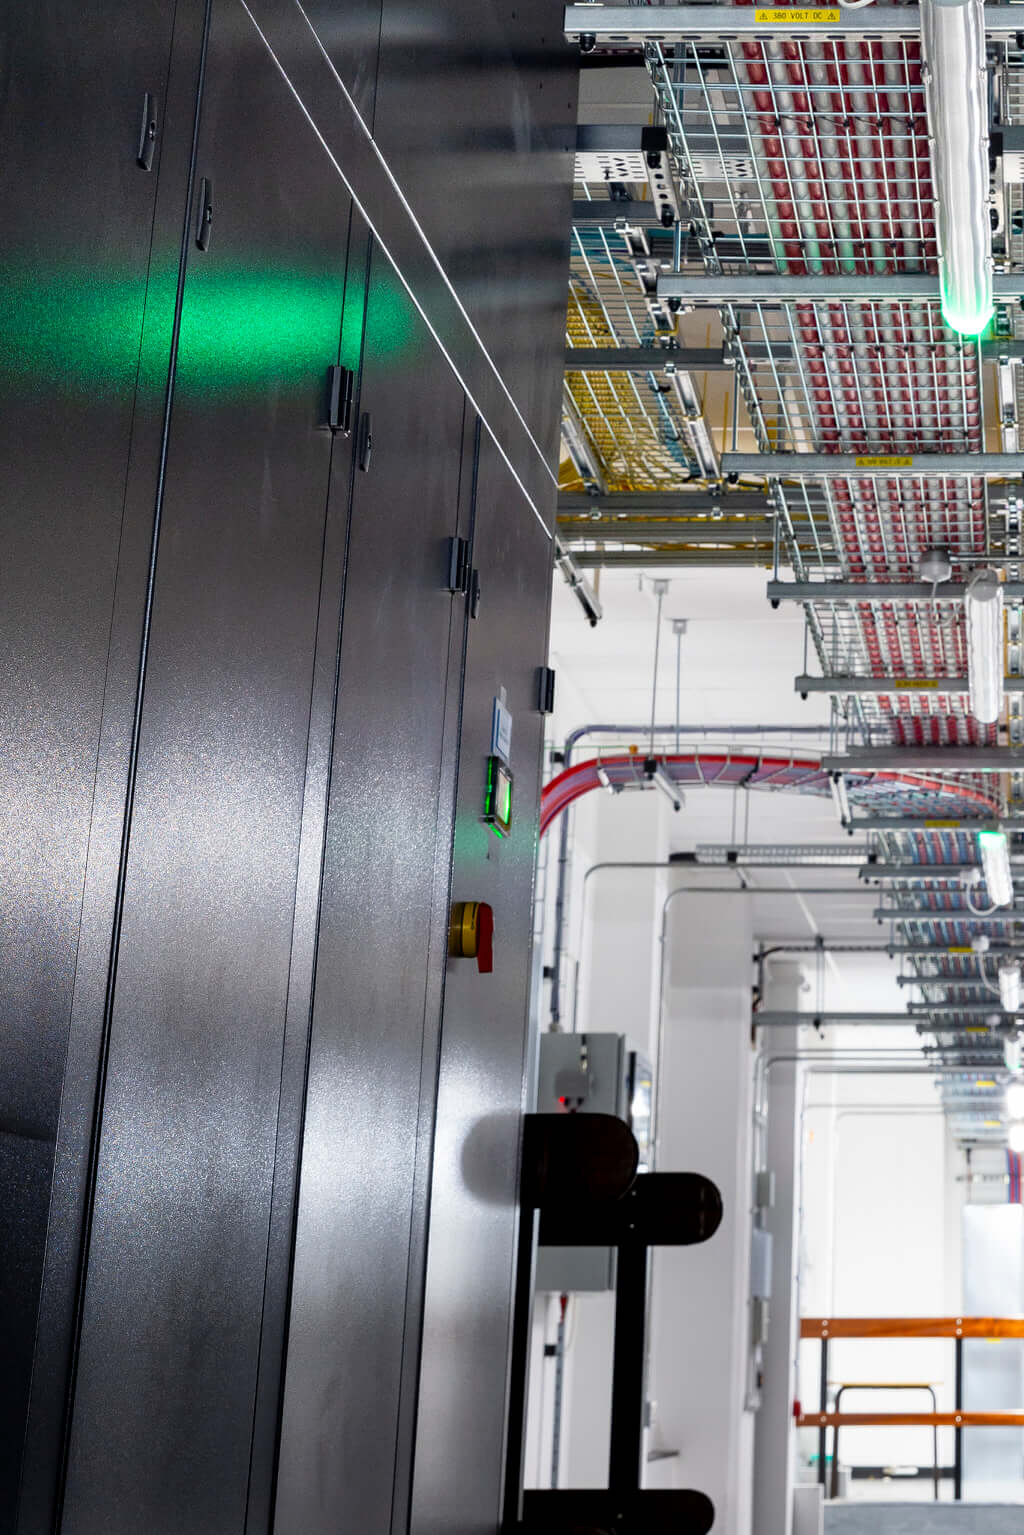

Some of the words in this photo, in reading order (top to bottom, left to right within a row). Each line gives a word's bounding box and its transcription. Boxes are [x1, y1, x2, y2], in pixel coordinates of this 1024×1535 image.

[772, 12, 787, 20] 380
[790, 12, 809, 20] VOLT
[813, 12, 823, 20] DC
